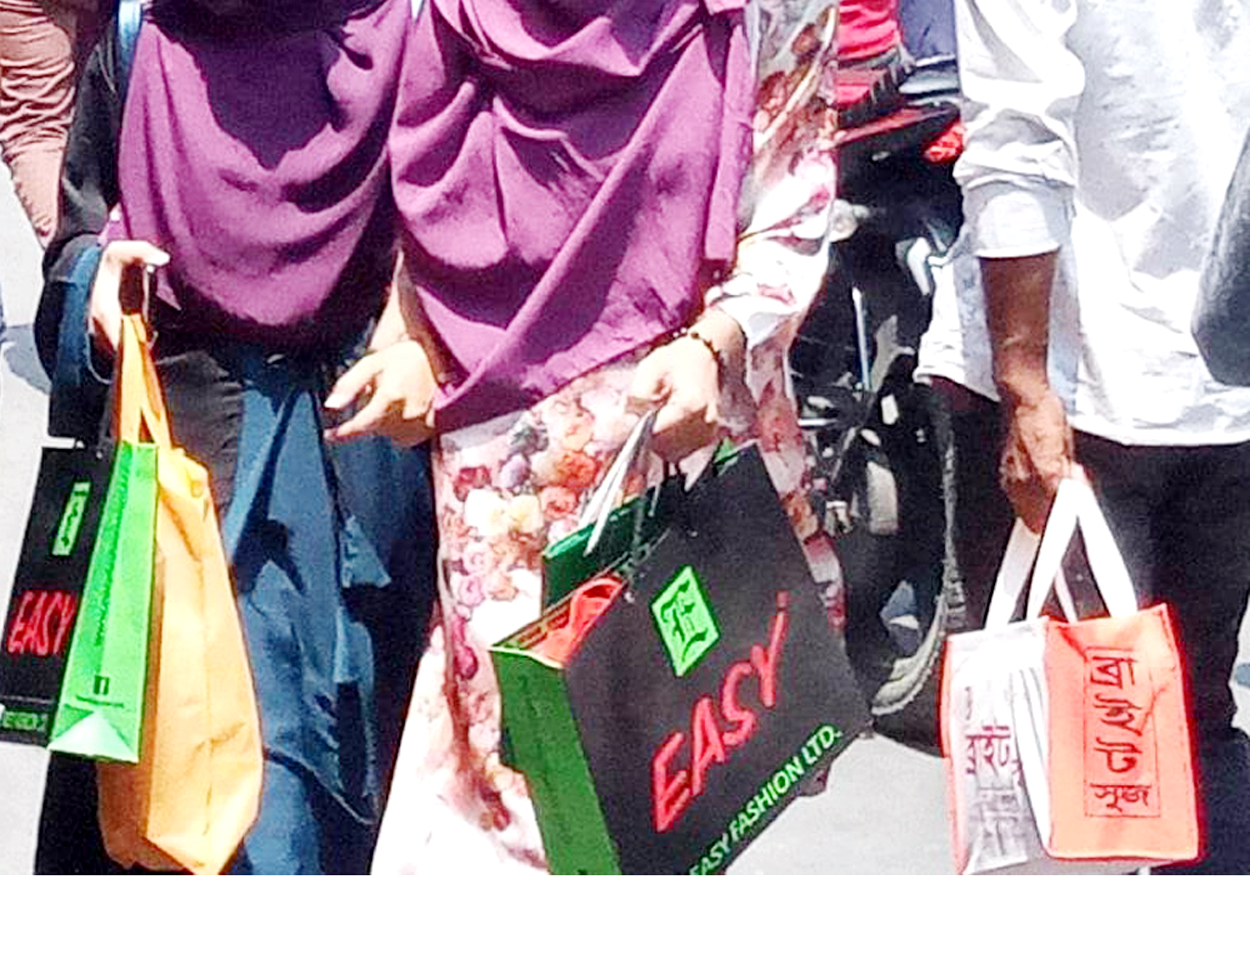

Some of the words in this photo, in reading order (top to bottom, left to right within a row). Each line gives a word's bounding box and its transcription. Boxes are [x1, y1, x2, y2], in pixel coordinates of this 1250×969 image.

[7, 591, 76, 656] EASY
[652, 590, 790, 833] EASY
[729, 756, 805, 842] FASHION
[801, 725, 843, 765] LTD.
